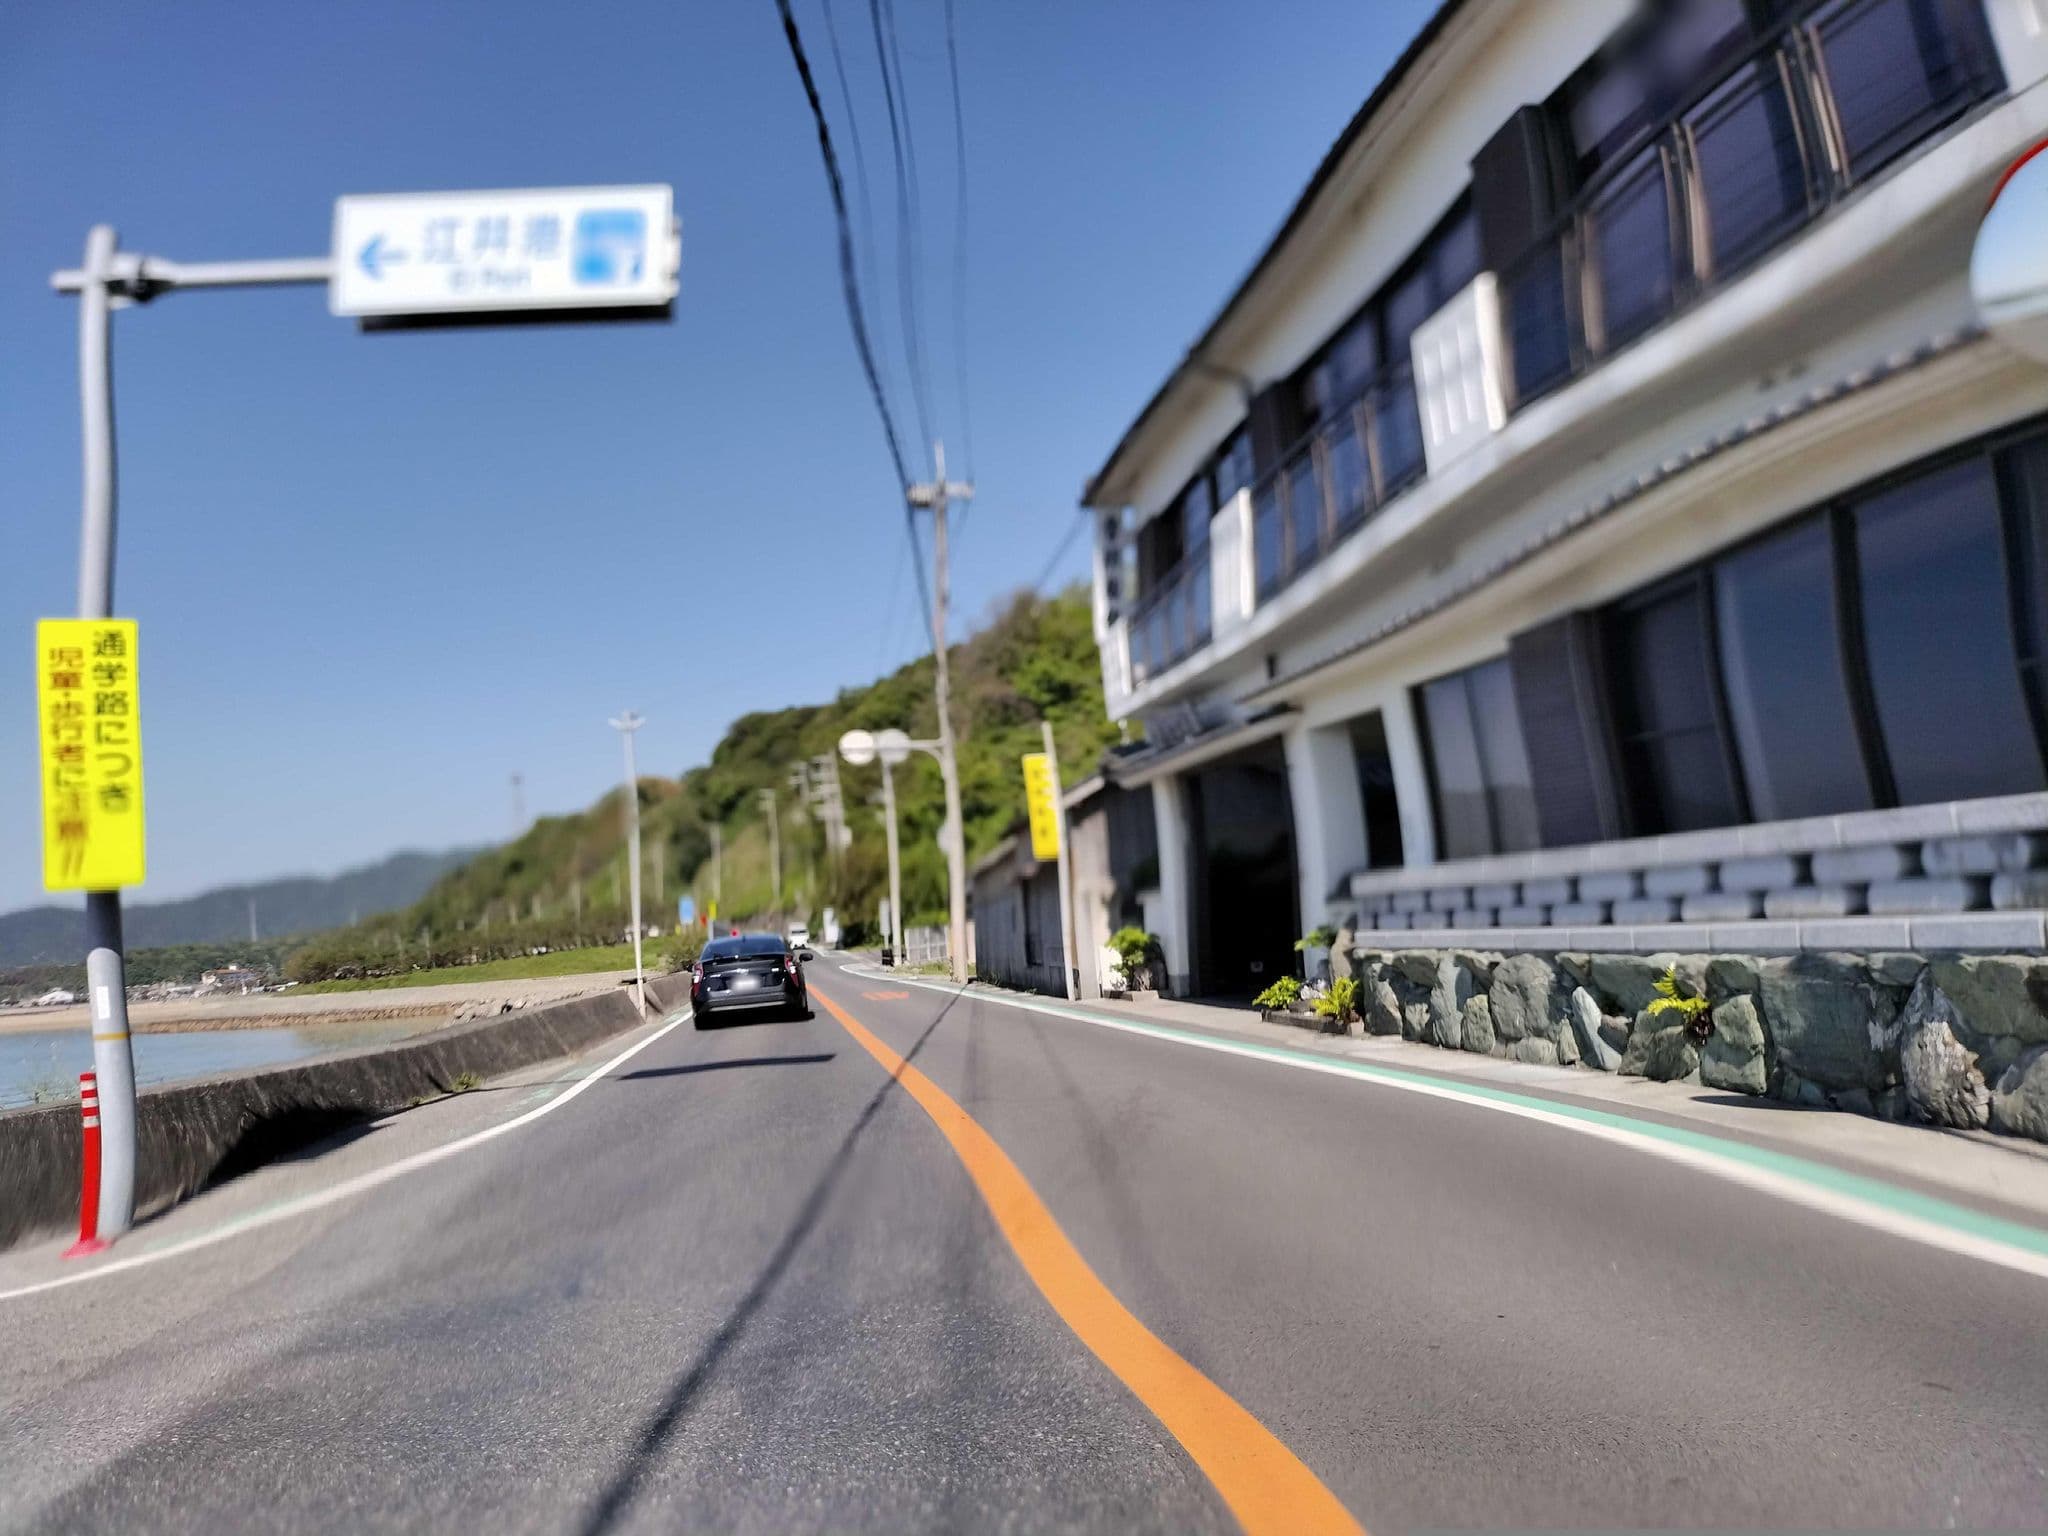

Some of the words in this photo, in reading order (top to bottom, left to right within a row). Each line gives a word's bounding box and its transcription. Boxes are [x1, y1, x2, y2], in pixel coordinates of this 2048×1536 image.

[92, 629, 133, 814] 通学路につき
